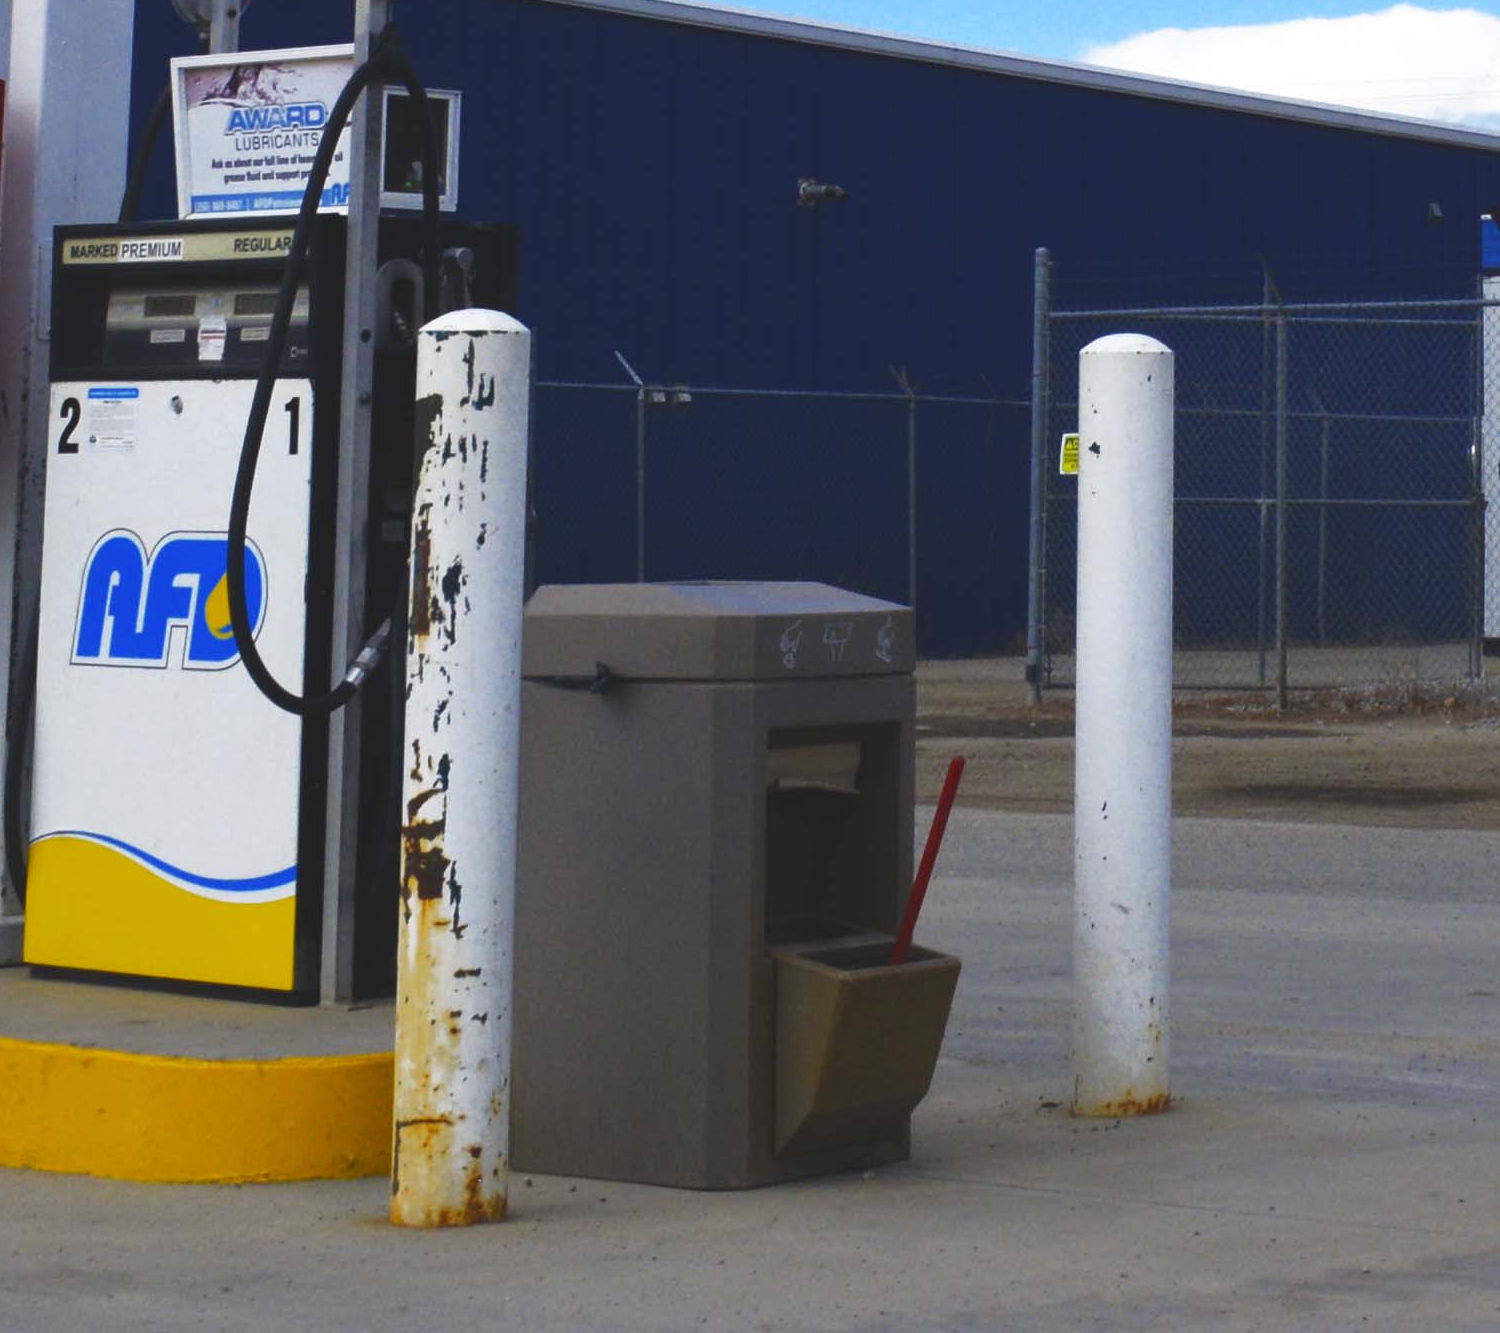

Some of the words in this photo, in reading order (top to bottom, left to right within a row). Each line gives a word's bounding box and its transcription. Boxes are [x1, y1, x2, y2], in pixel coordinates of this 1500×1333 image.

[225, 103, 326, 134] AWARD
[235, 132, 319, 152] LUBRICANTS
[211, 159, 223, 169] Ask
[234, 158, 252, 168] about
[277, 155, 289, 165] line
[290, 153, 298, 164] of
[262, 170, 274, 180] and
[276, 168, 301, 181] support
[70, 243, 118, 259] MARKED
[121, 241, 182, 259] PREMIUM
[234, 236, 291, 253] REGULAR
[58, 397, 82, 454] 2
[284, 395, 301, 455] 1
[73, 531, 266, 668] AFD
